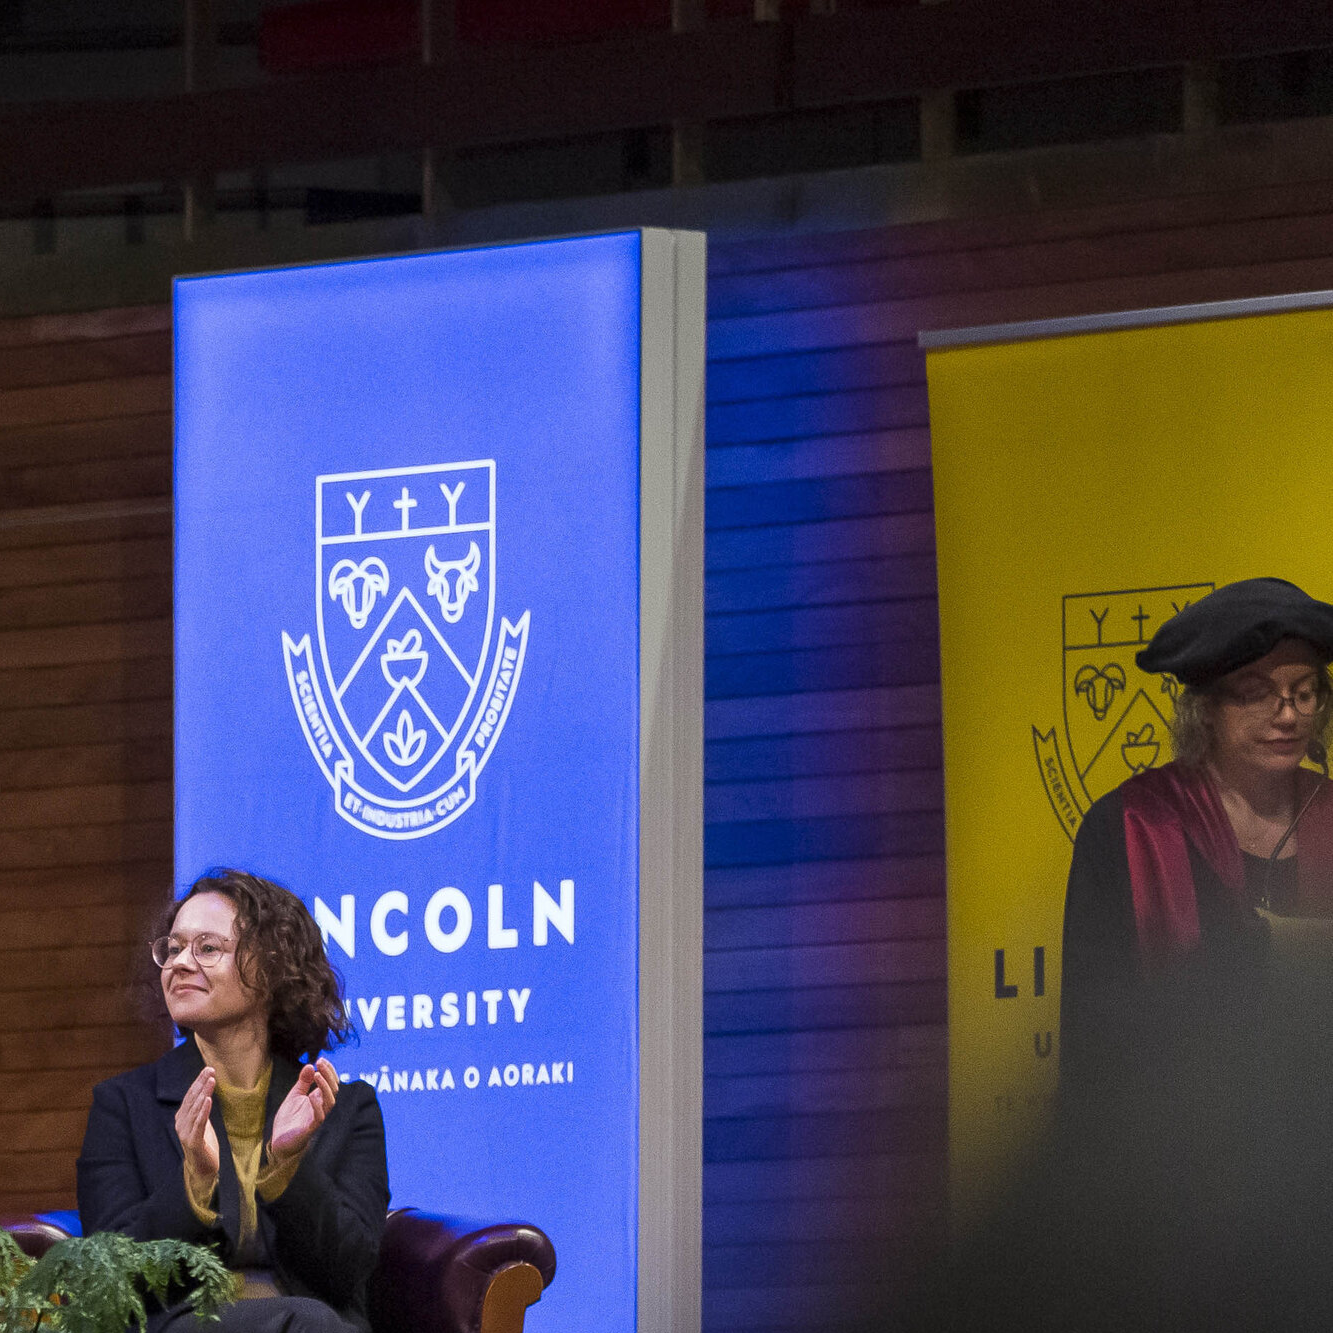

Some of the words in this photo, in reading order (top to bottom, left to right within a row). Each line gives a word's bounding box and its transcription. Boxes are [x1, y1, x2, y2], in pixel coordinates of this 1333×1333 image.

[295, 670, 334, 759] SCIENTIA
[1044, 757, 1078, 829] SCIENTIA
[314, 879, 575, 959] NCOLN
[342, 988, 531, 1032] VERSITY
[463, 1066, 480, 1089] O
[488, 1061, 574, 1088] AORAKI
